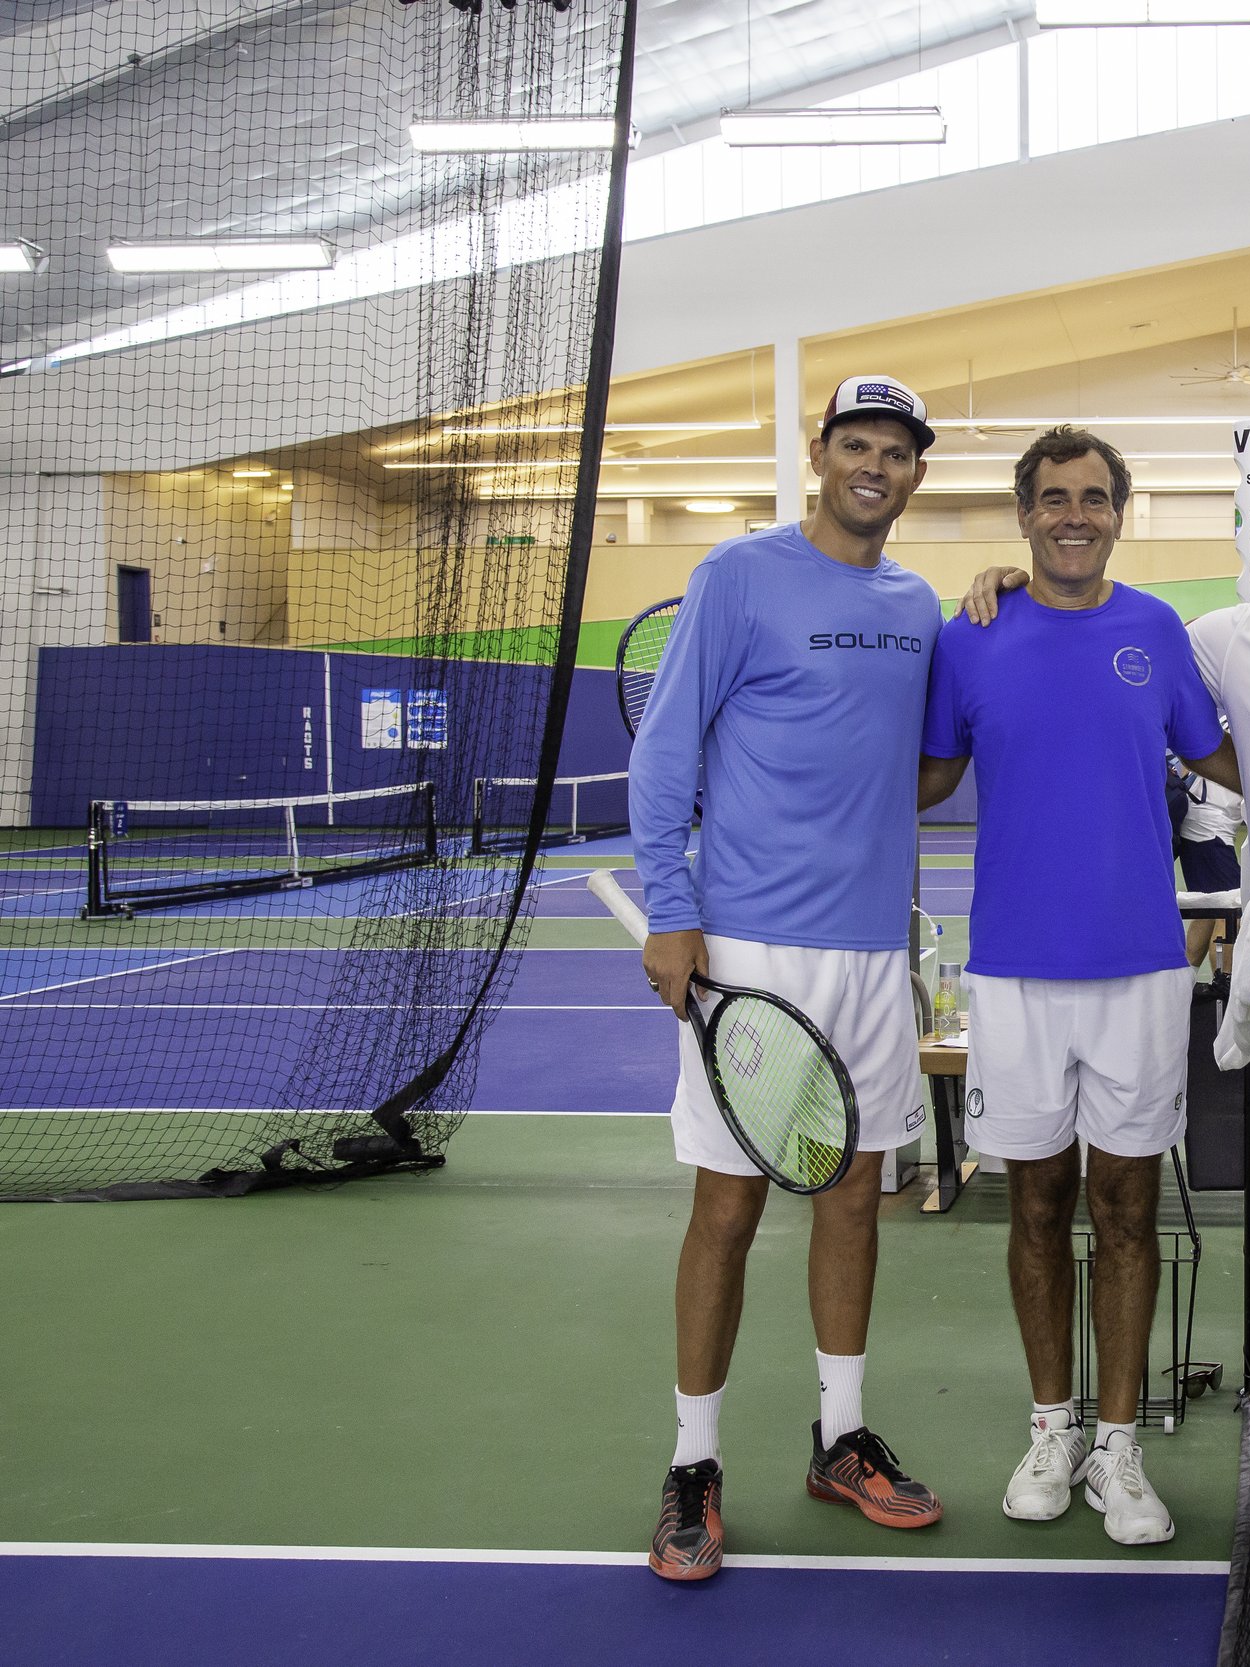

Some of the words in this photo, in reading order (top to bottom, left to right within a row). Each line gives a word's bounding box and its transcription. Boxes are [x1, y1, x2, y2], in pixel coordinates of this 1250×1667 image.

[859, 393, 912, 413] SOLINCO
[1233, 428, 1250, 454] V
[808, 632, 922, 654] SOLINCO
